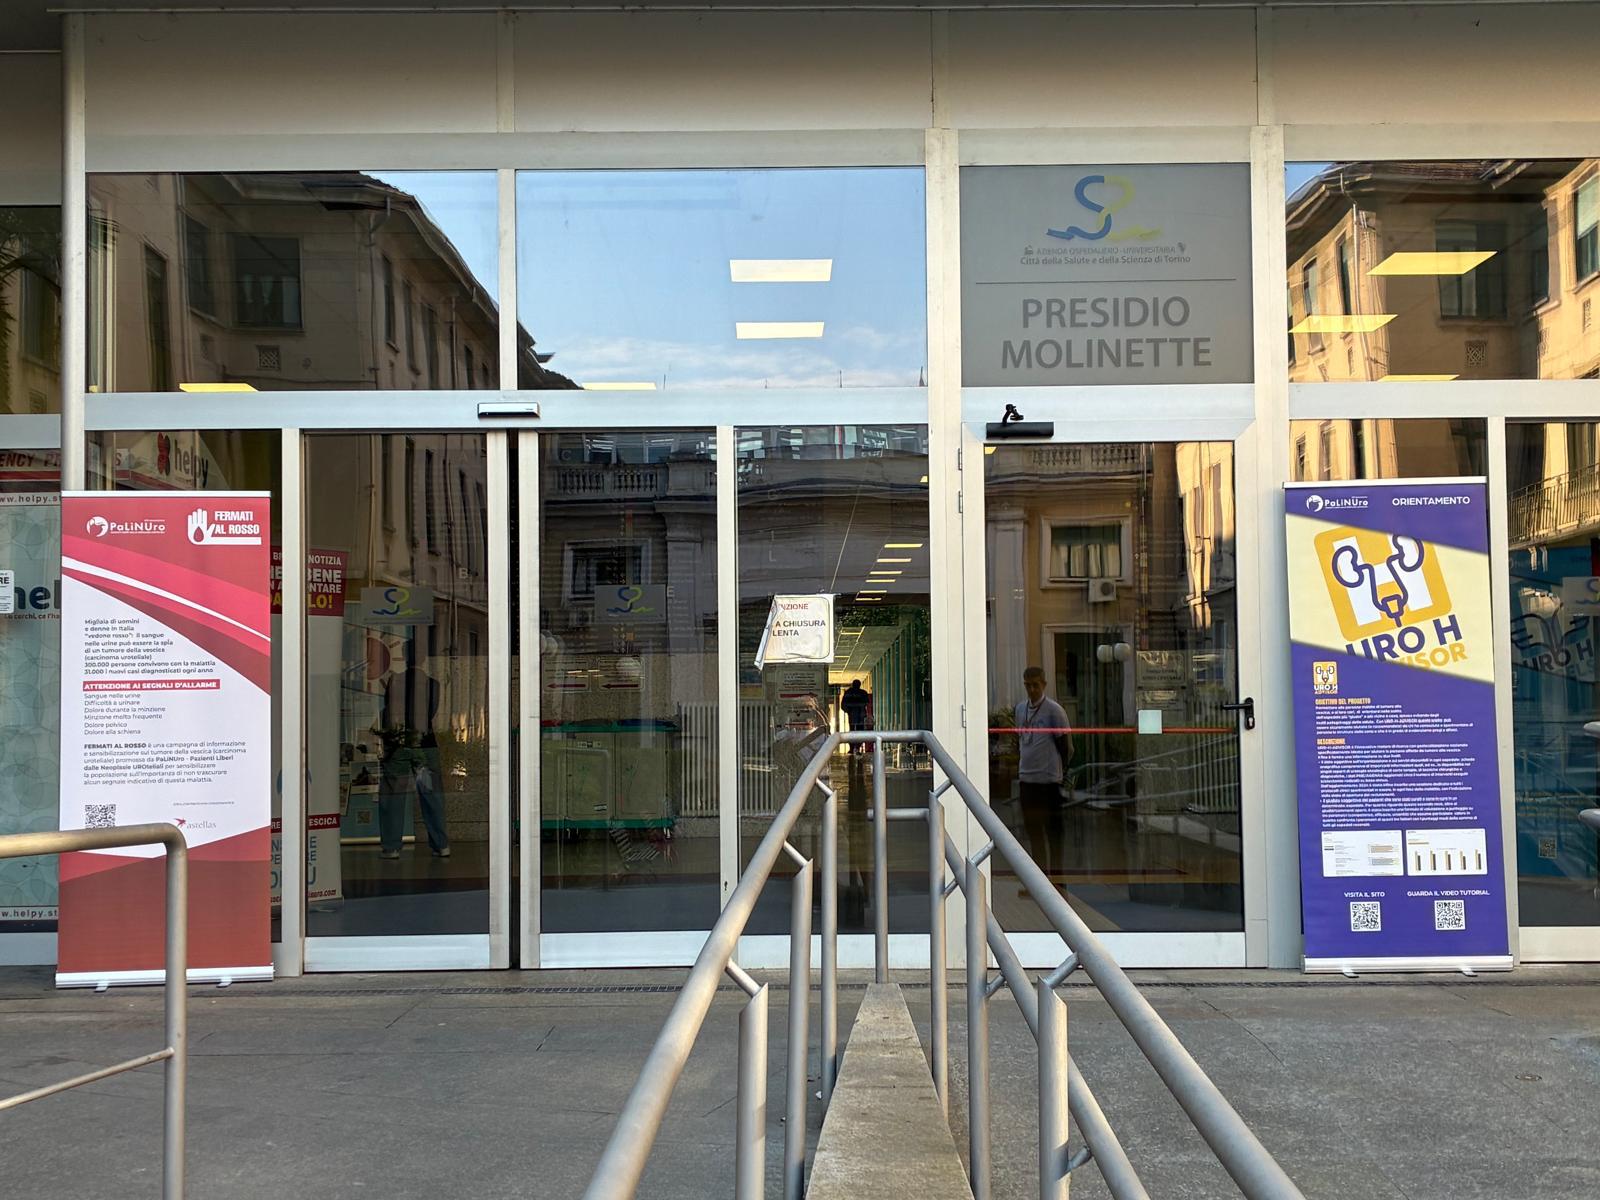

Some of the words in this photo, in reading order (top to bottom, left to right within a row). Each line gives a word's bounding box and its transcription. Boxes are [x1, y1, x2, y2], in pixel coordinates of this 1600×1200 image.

[1020, 257, 1039, 265] Città
[1022, 296, 1190, 328] PRESIDIO
[1002, 337, 1211, 369] MOLINETTE
[174, 439, 208, 488] helpy
[1392, 496, 1470, 506] ORIENTAMENTO
[215, 511, 253, 521] FERMATI
[110, 521, 165, 532] PaLiNUro
[214, 524, 226, 534] AL
[229, 524, 260, 534] ROSSO
[308, 555, 341, 565] NOTIZIA
[1346, 626, 1425, 661] URO
[1432, 614, 1462, 646] H
[187, 819, 216, 829] astellas
